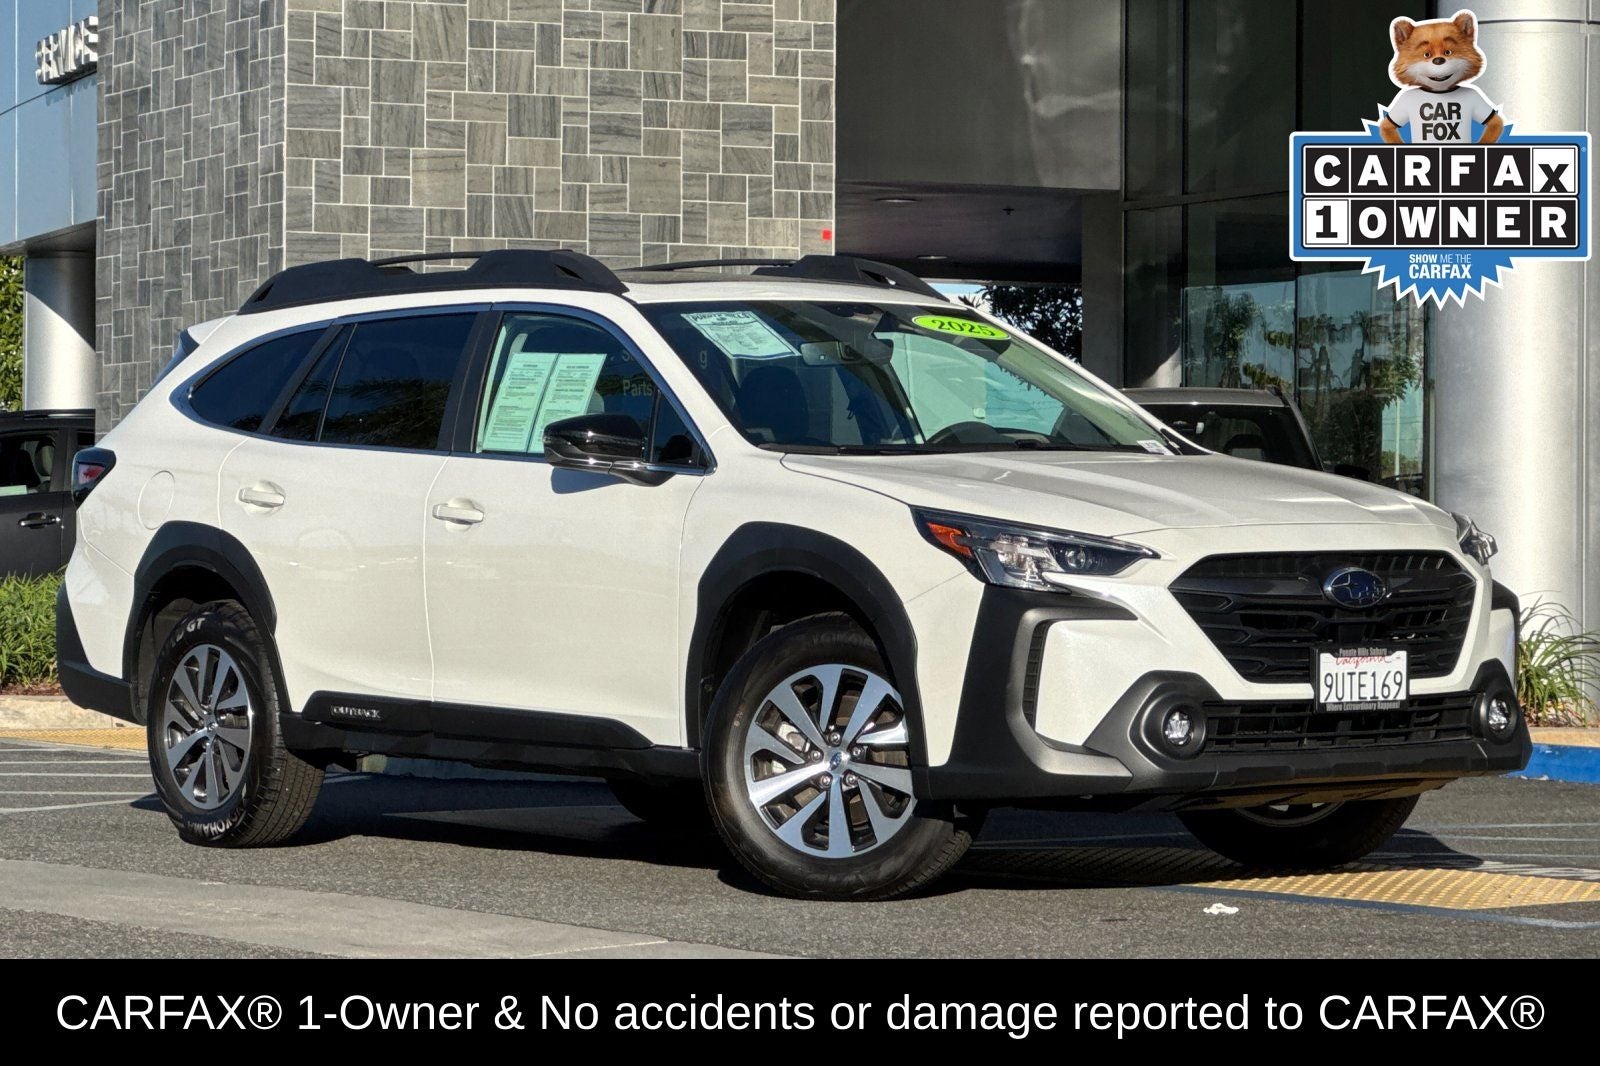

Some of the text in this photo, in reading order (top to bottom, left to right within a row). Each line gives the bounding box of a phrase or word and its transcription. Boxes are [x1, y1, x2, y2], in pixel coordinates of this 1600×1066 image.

[931, 318, 996, 337] 2025
[622, 379, 653, 397] Parts
[186, 616, 206, 633] GT
[1324, 670, 1403, 701] 9UTE169
